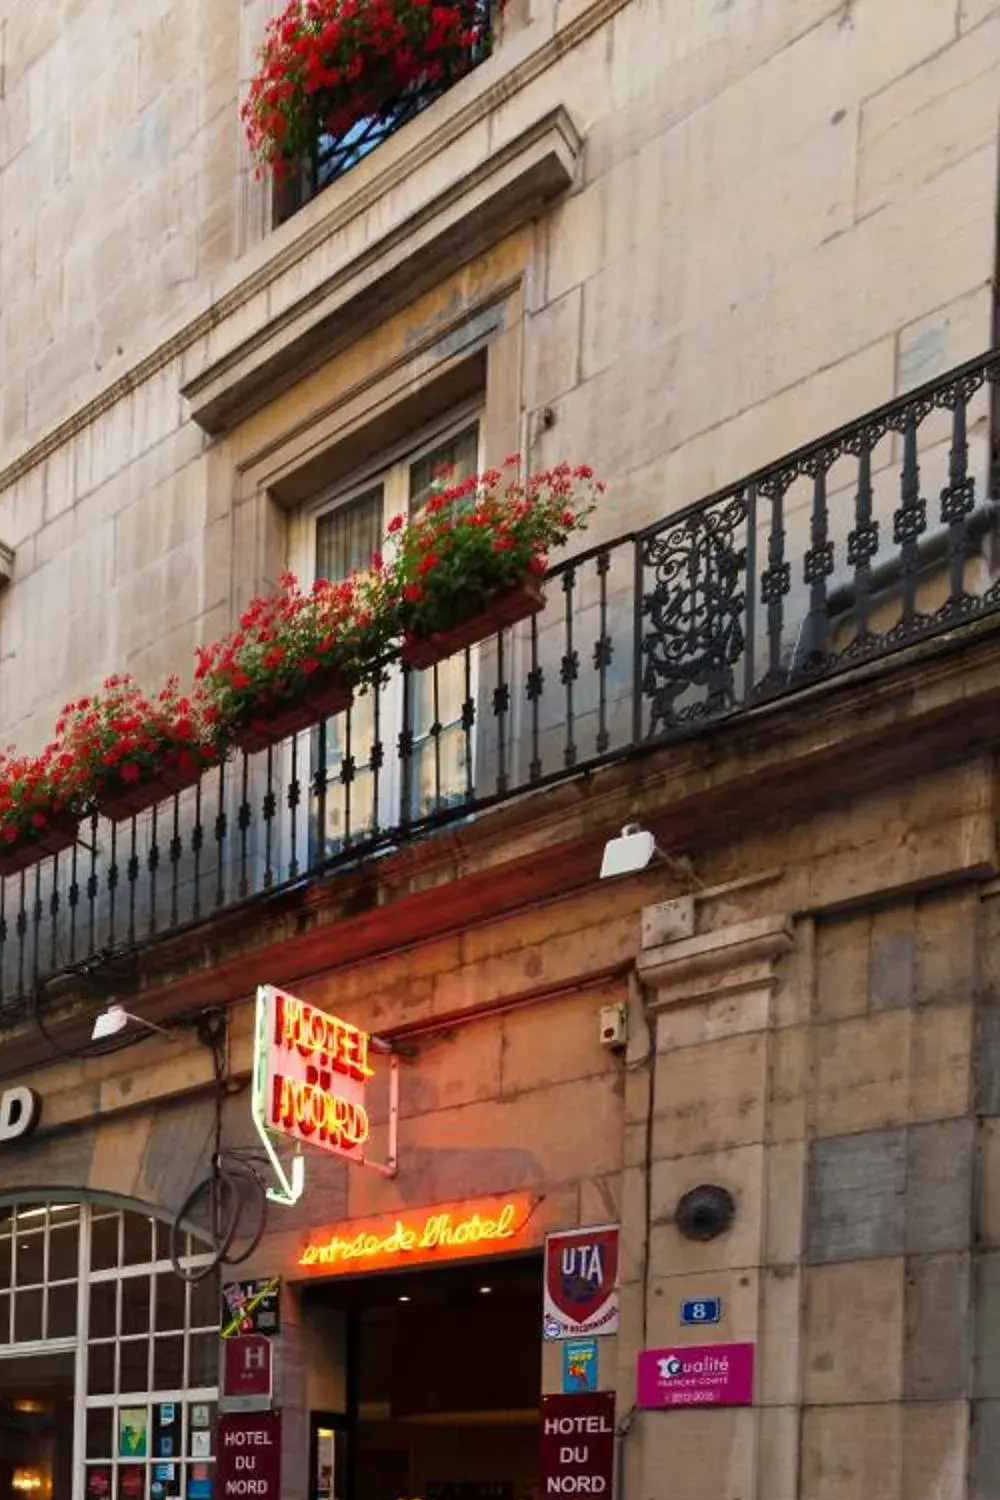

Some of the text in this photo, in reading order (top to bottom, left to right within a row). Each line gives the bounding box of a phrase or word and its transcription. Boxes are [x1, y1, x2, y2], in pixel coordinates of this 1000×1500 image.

[274, 995, 375, 1083] HOTEL
[272, 1074, 369, 1149] NORD
[562, 1244, 604, 1286] UTA
[692, 1303, 706, 1319] 8
[244, 1345, 264, 1369] H
[667, 1355, 729, 1375] Qualité
[544, 1415, 612, 1435] HOTEL
[224, 1431, 273, 1446] HOTEL
[235, 1455, 256, 1470] DU
[559, 1446, 589, 1463] DU
[226, 1479, 268, 1496] NORD
[546, 1475, 606, 1493] NORD
